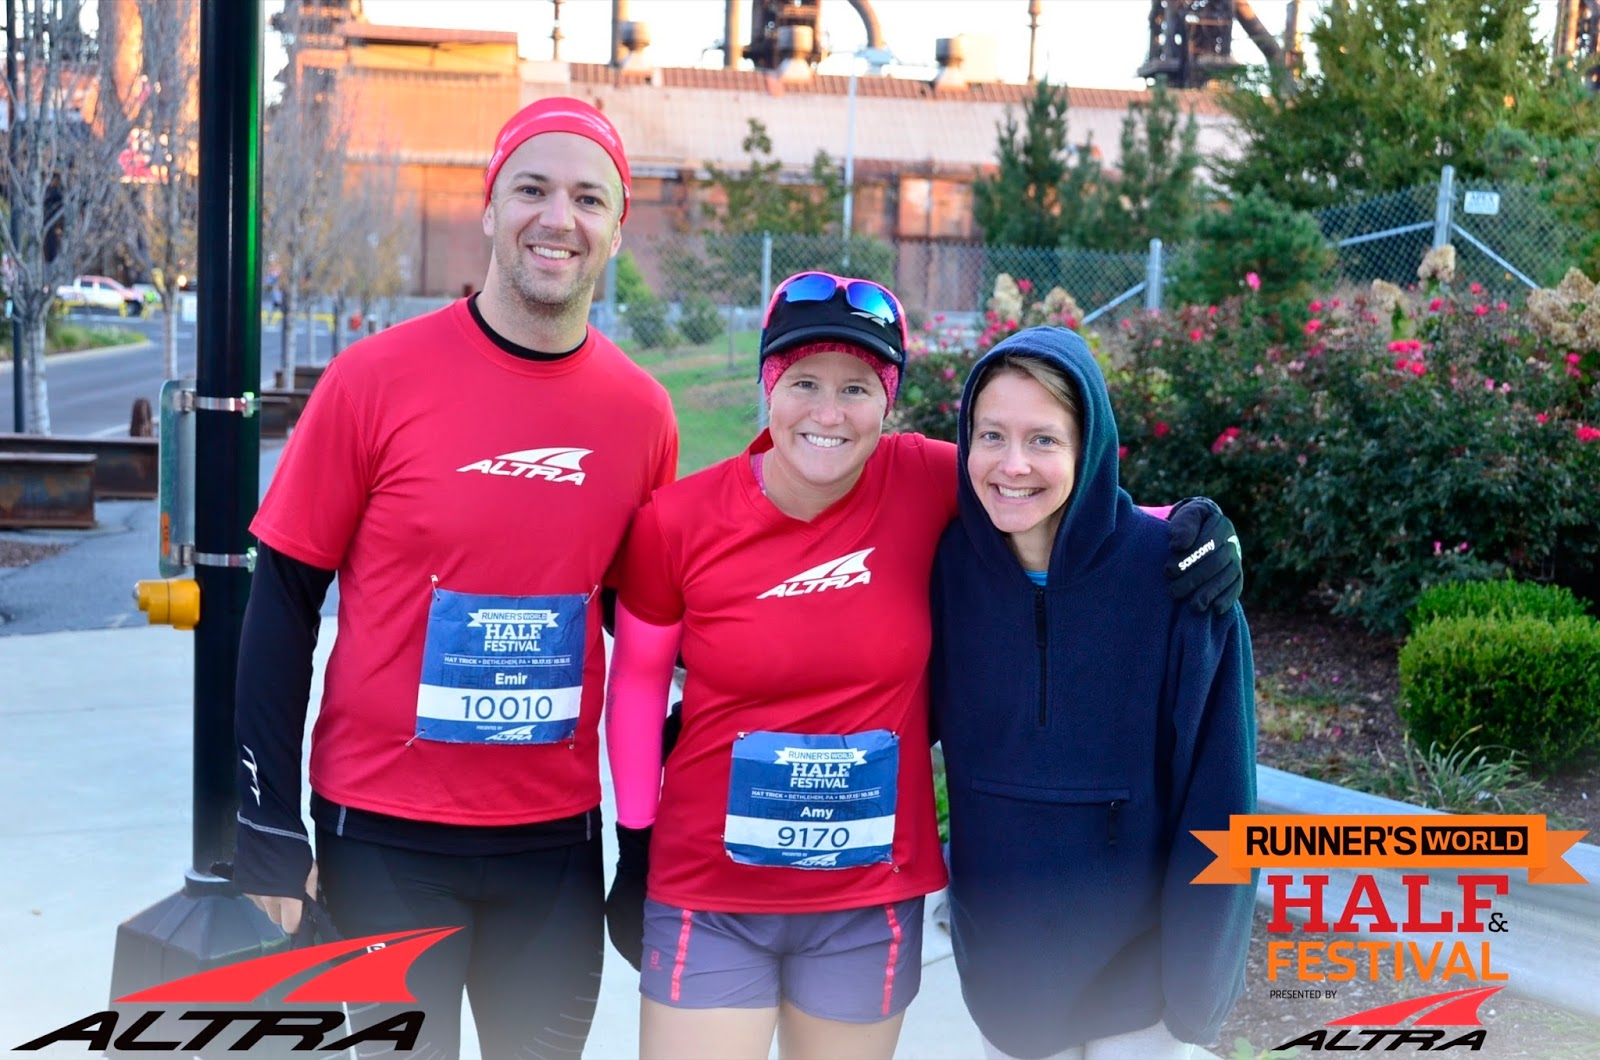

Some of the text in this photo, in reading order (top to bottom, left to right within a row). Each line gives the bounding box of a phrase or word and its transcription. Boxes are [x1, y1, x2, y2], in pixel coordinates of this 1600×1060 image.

[456, 459, 586, 486] ALTRA
[1178, 539, 1215, 571] saucony
[756, 570, 871, 599] ALTRA
[481, 611, 522, 621] RUNNER'S
[485, 624, 542, 640] HALF
[484, 640, 541, 652] FESTIVAL
[495, 673, 528, 685] Emir
[461, 695, 553, 720] 10010
[788, 750, 854, 760] RUNNER'S WORLD
[791, 763, 851, 778] HALF
[790, 778, 849, 789] FESTIVAL
[800, 806, 833, 820] Amy
[778, 826, 850, 848] 9170
[790, 859, 837, 867] ALTRA
